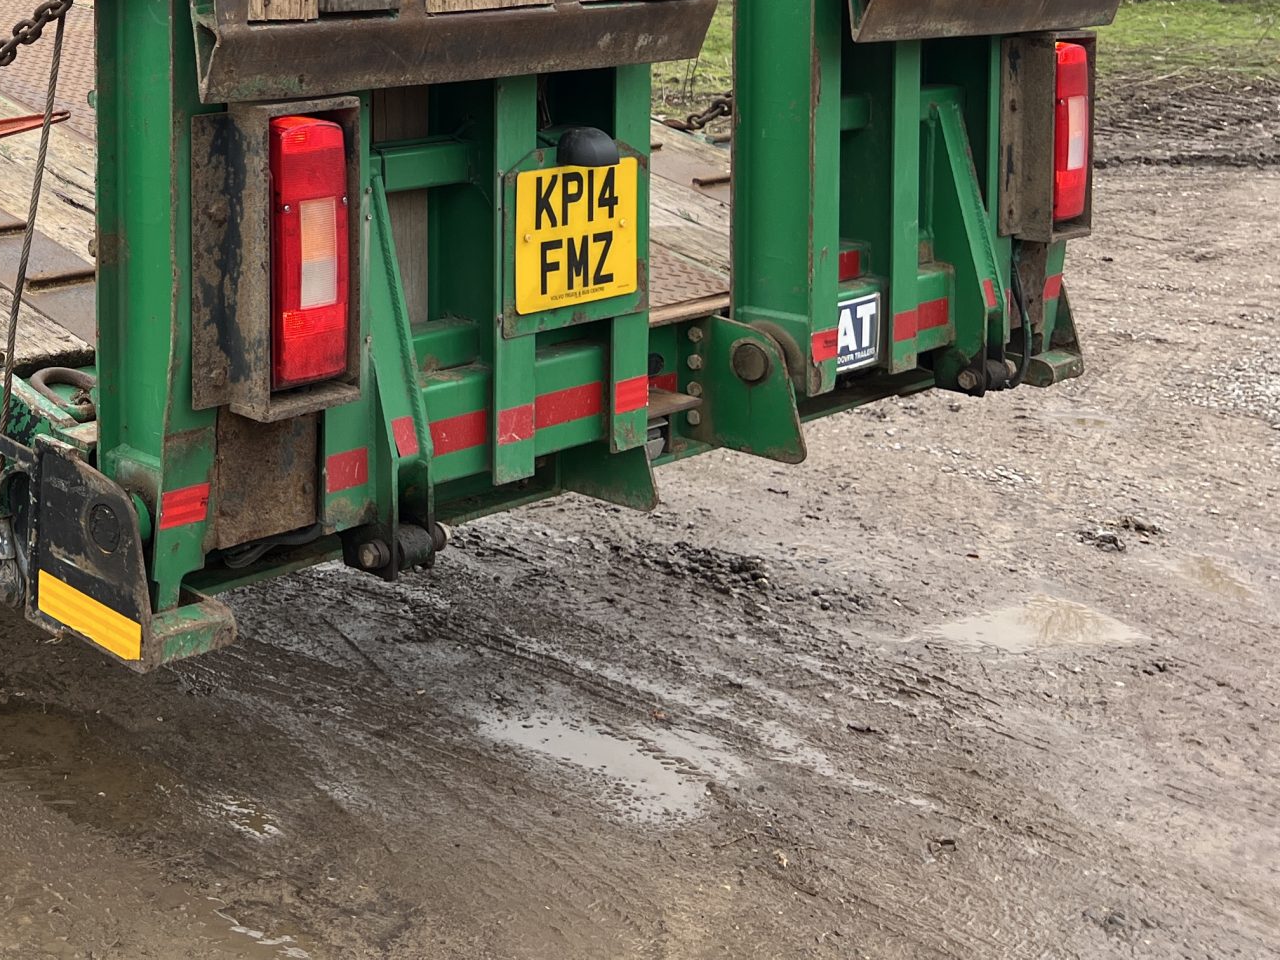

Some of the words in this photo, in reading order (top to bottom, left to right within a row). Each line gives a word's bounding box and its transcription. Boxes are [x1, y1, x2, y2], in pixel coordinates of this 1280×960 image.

[535, 167, 619, 230] KP14
[540, 230, 614, 296] FMZ
[837, 301, 876, 354] AT
